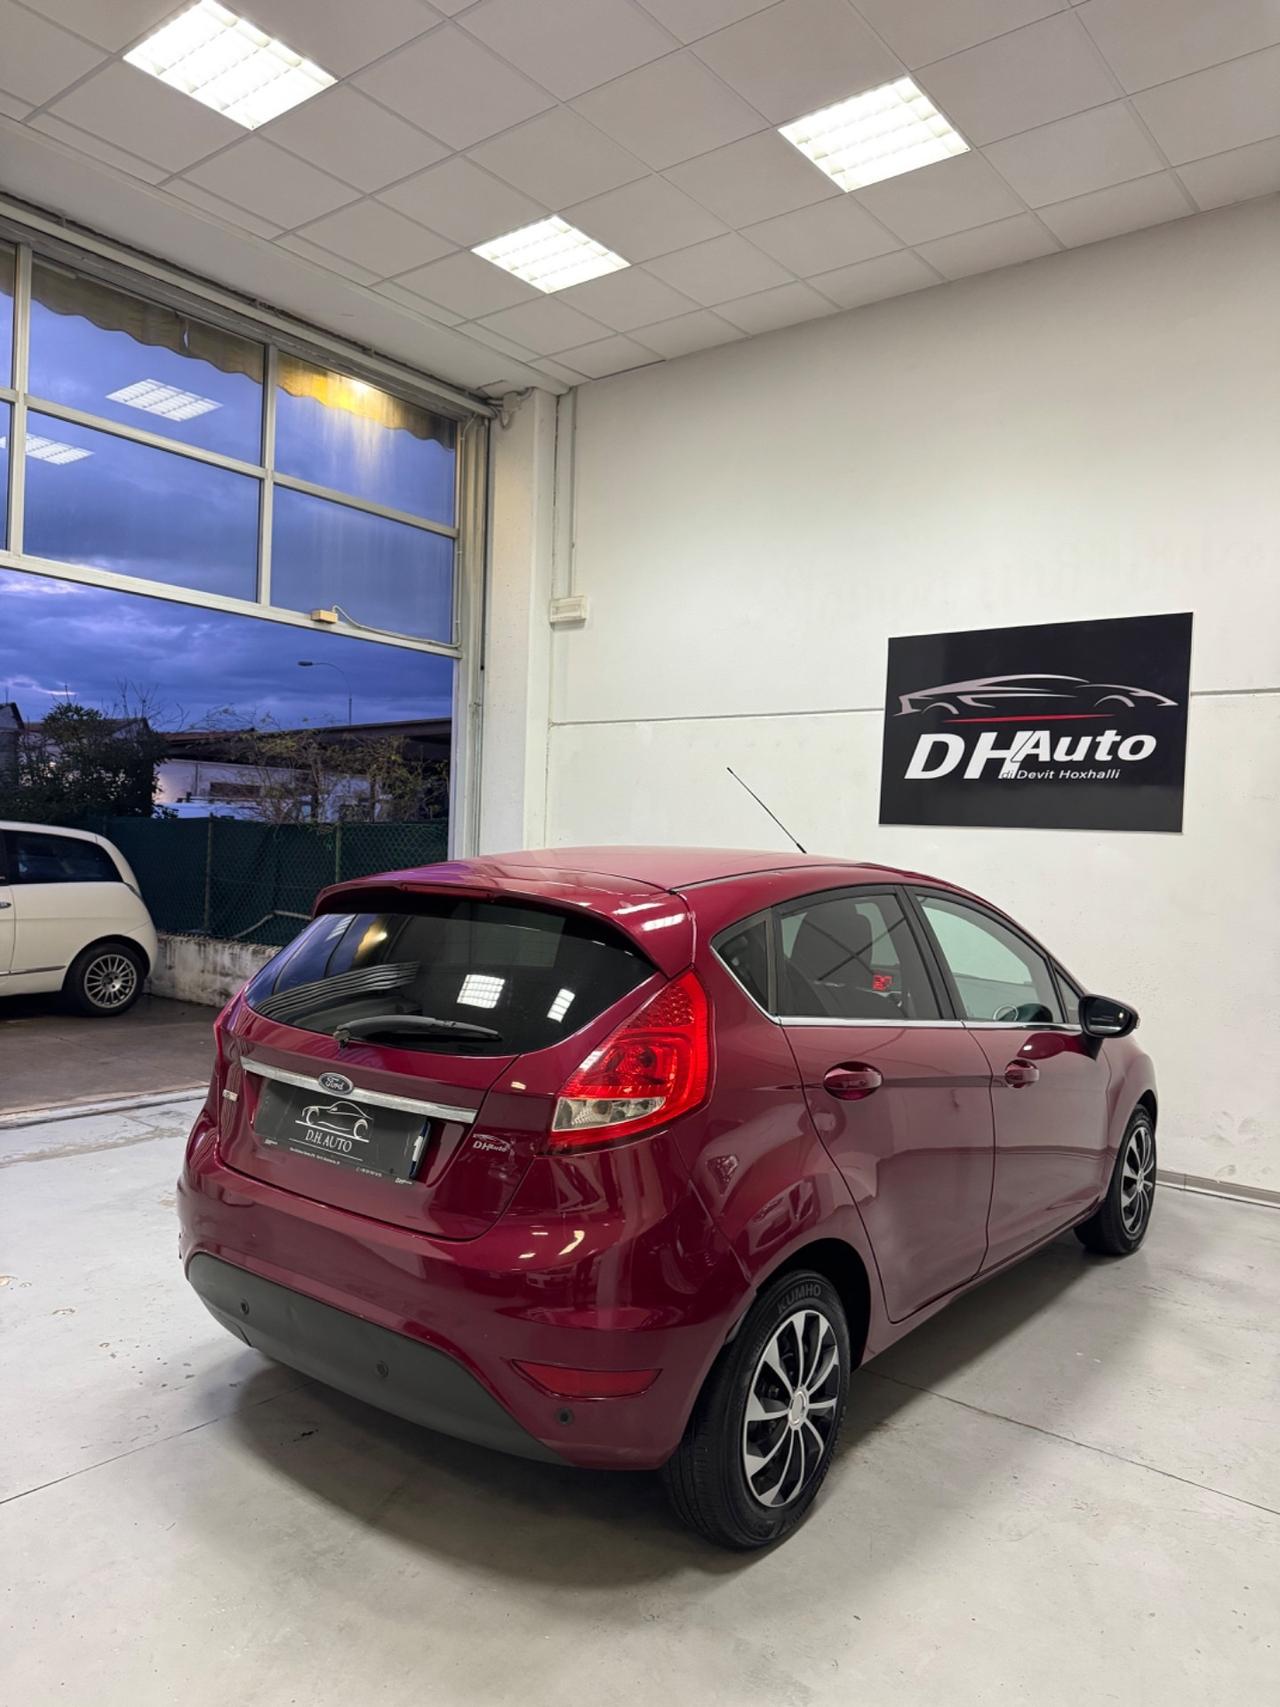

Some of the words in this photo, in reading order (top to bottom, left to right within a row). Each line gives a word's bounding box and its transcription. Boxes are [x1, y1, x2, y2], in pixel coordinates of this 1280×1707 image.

[1016, 769, 1055, 780] Devit
[1059, 768, 1121, 780] Hoxhalli
[322, 1135, 353, 1153] AUTO
[776, 1283, 821, 1314] KUMHO
